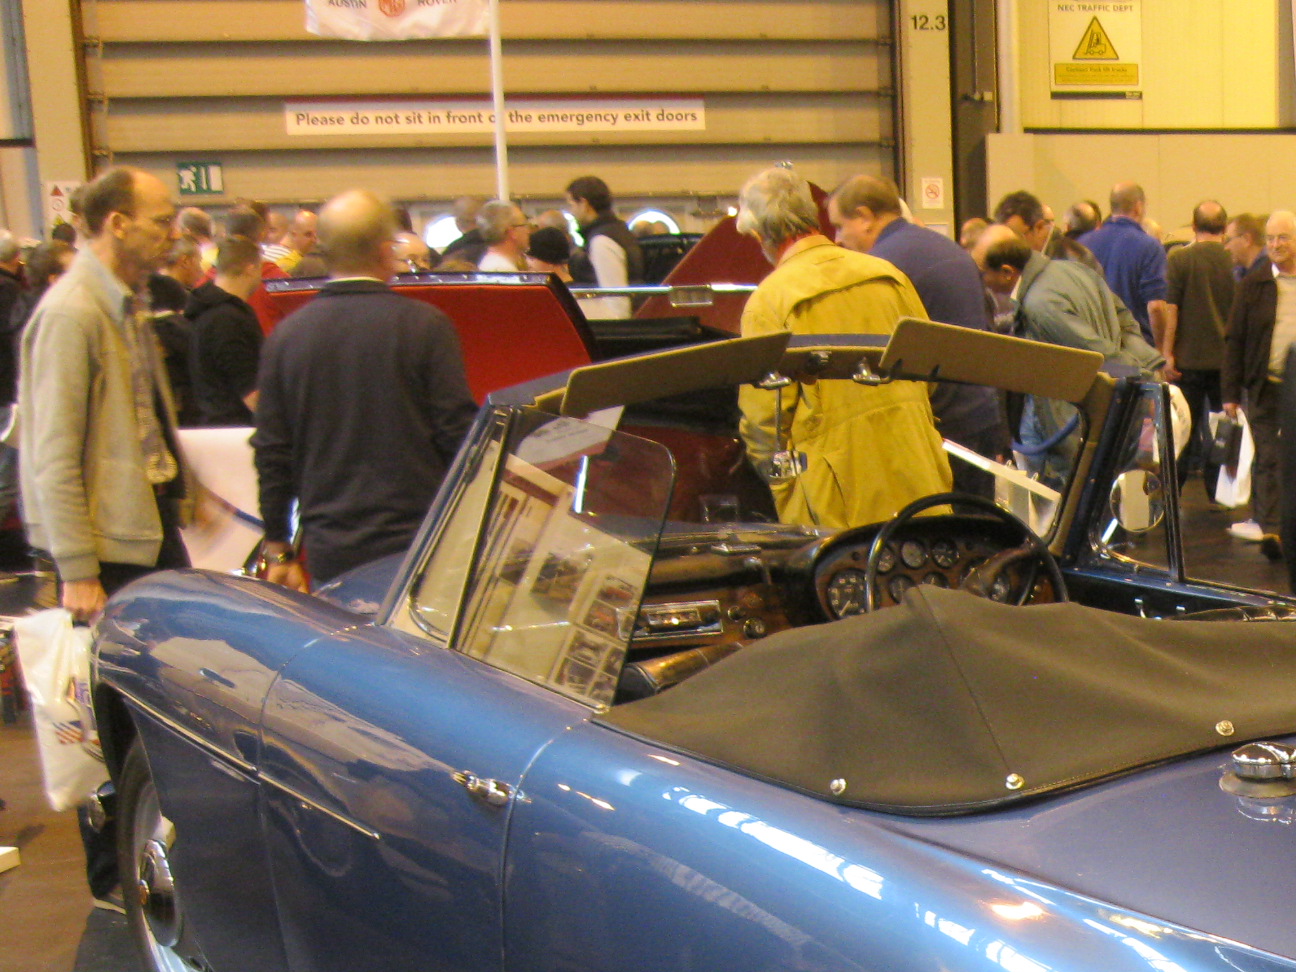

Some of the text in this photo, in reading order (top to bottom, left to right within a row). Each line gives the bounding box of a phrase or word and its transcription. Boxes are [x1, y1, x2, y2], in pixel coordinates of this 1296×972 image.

[1057, 4, 1133, 12] NEC TRAFFIC DEPT
[911, 14, 946, 31] 12.3
[296, 112, 345, 126] Please
[350, 112, 370, 125] do
[375, 113, 400, 125] not
[405, 112, 423, 124] sit
[428, 111, 441, 124] in
[447, 110, 483, 124] front
[508, 110, 532, 123] the
[538, 111, 619, 126] emergency
[624, 109, 651, 122] exit
[656, 108, 697, 122] doors
